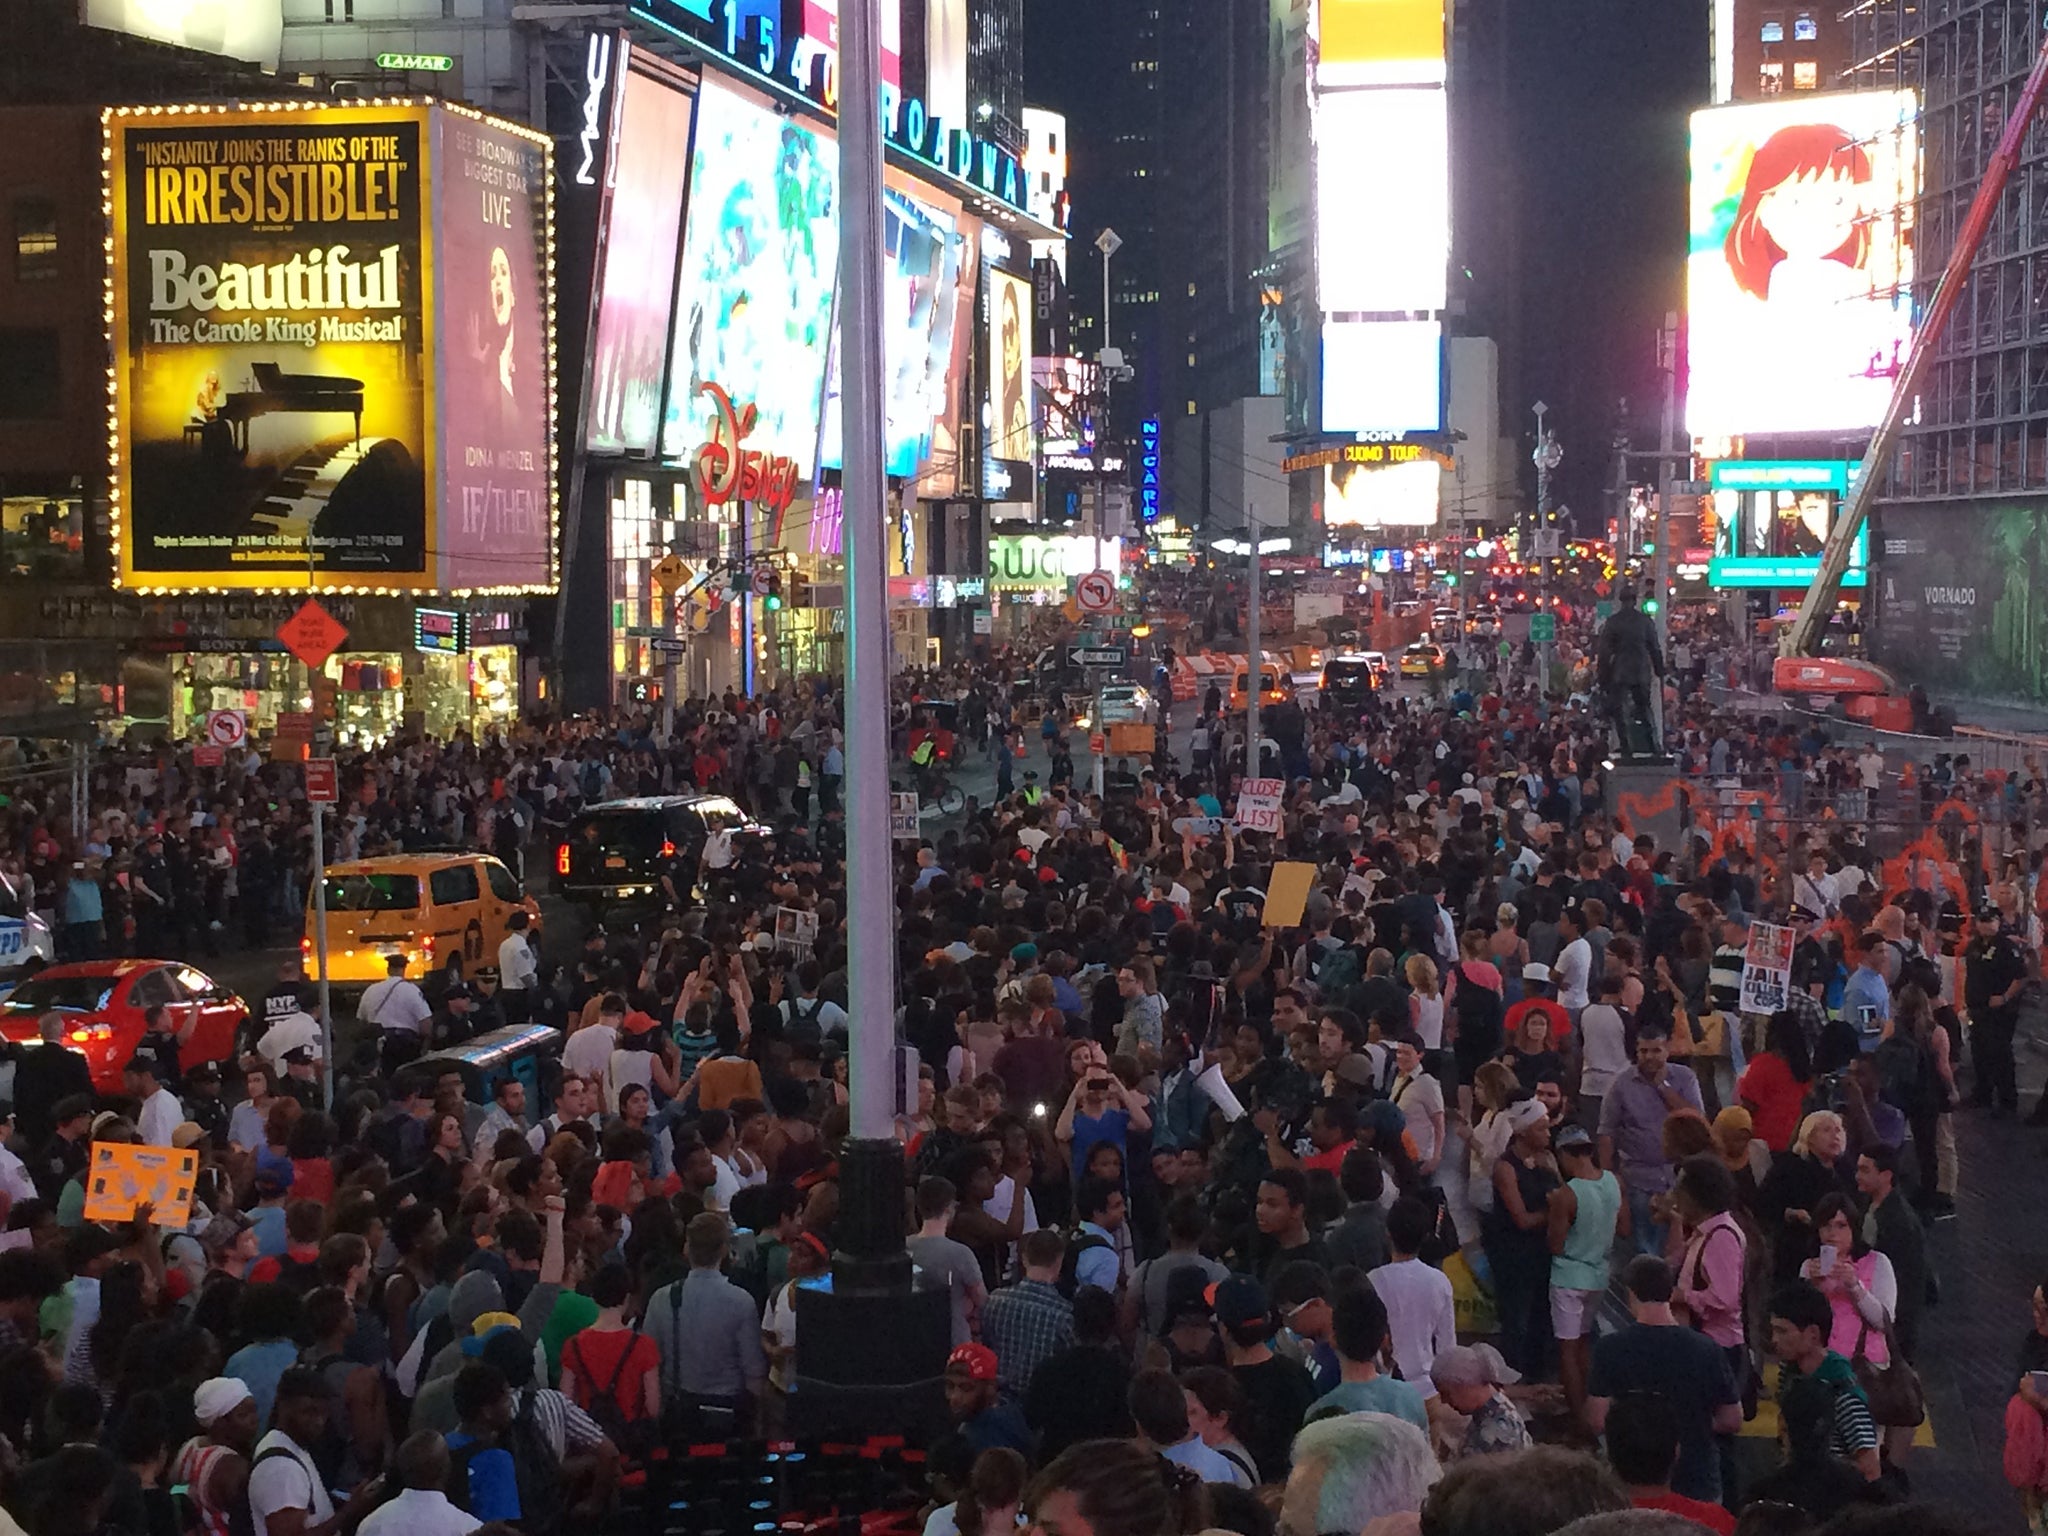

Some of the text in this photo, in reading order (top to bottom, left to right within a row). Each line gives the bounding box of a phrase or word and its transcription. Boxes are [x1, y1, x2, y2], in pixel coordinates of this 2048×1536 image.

[382, 54, 447, 70] LAMAR
[723, 0, 838, 105] 1540
[221, 138, 264, 164] JOINS
[267, 138, 292, 162] THE
[298, 137, 346, 160] RANKS
[350, 136, 368, 160] OF
[370, 136, 399, 160] THE
[464, 158, 528, 194] BIGGEST STAR
[482, 190, 511, 229] LIVE
[149, 244, 401, 312] Beautiful
[150, 315, 401, 347] The Carole King Musical
[1355, 431, 1406, 442] SONY
[465, 446, 493, 467] IDINA
[1344, 446, 1384, 461] CUOMO
[1924, 586, 1976, 605] VORNADO
[200, 640, 247, 650] SONY
[1242, 780, 1282, 797] CLOSE
[1241, 808, 1276, 827] LIST
[1745, 966, 1783, 986] JAIL
